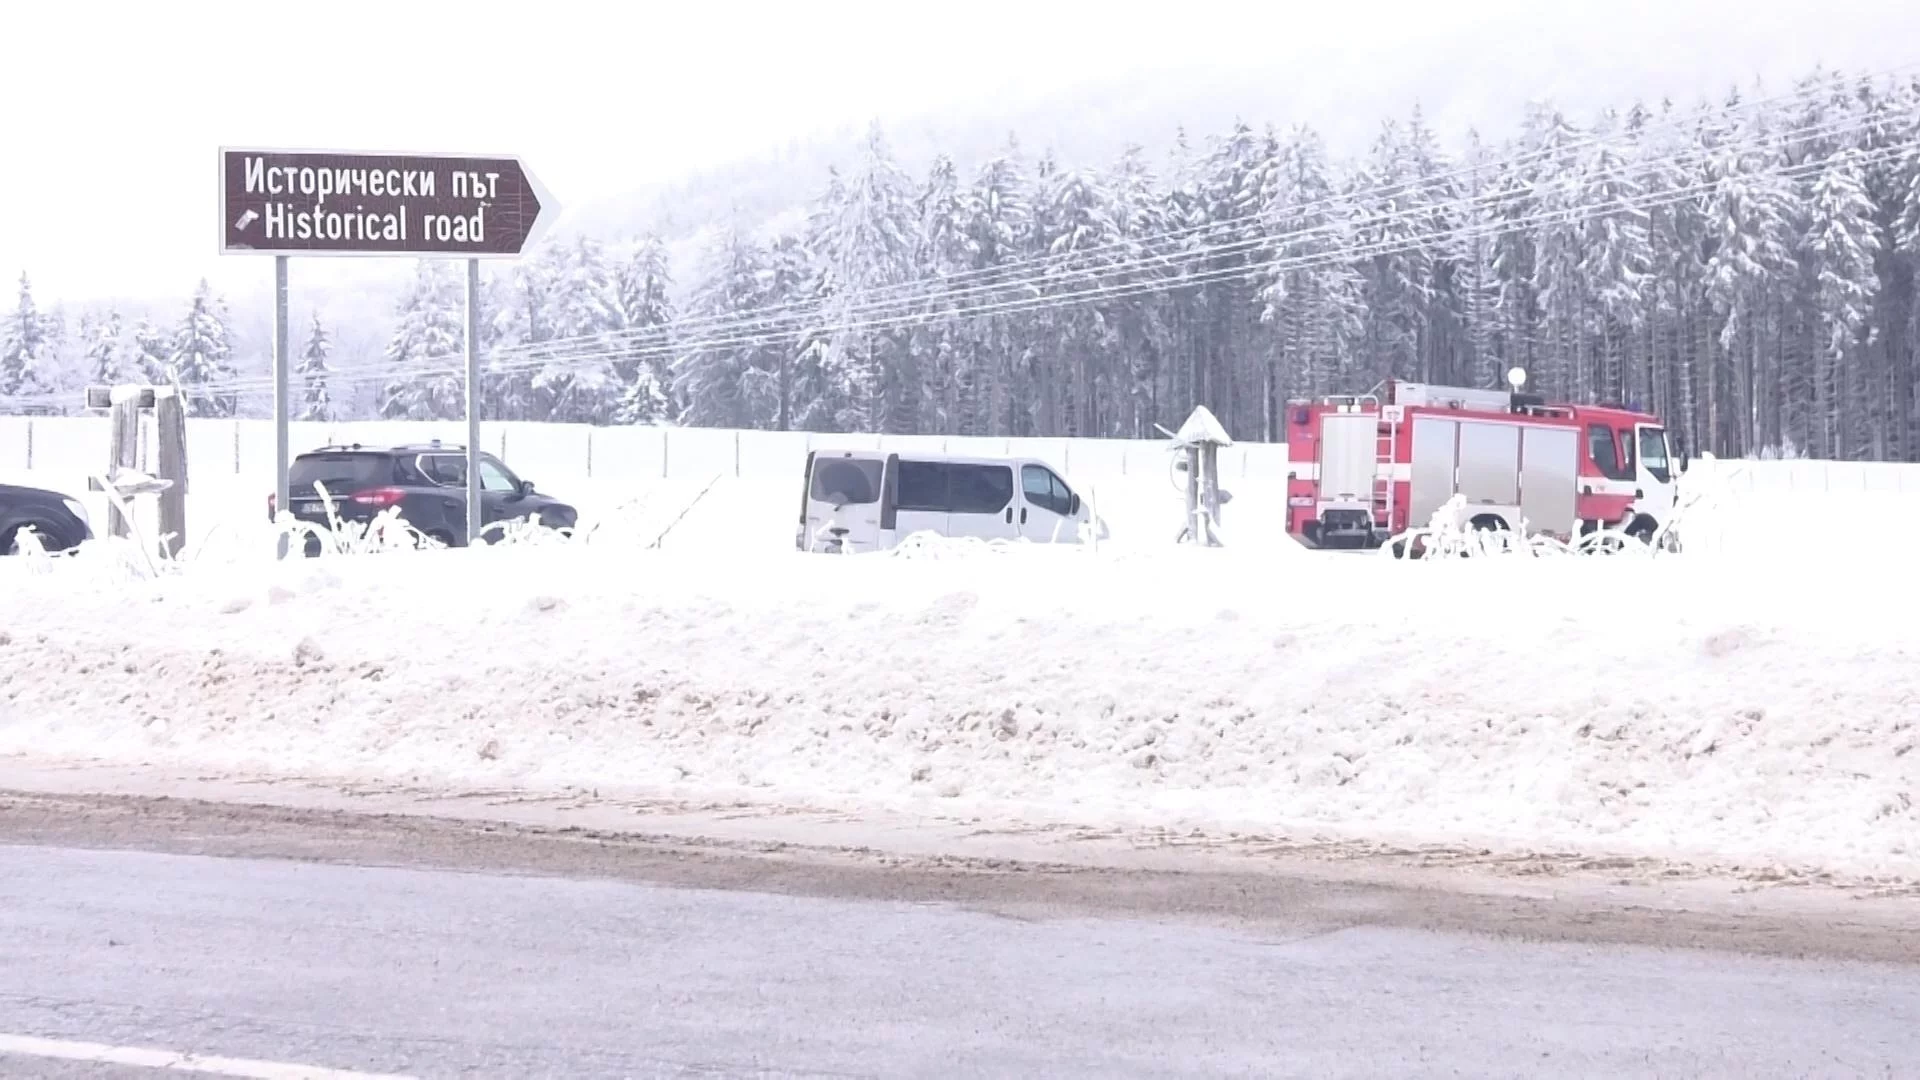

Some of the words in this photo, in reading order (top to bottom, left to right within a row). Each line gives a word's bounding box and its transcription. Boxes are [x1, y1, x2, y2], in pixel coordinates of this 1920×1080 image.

[244, 156, 435, 204] Исторически
[452, 171, 500, 199] път
[265, 202, 407, 241] Historical
[424, 206, 485, 243] road
